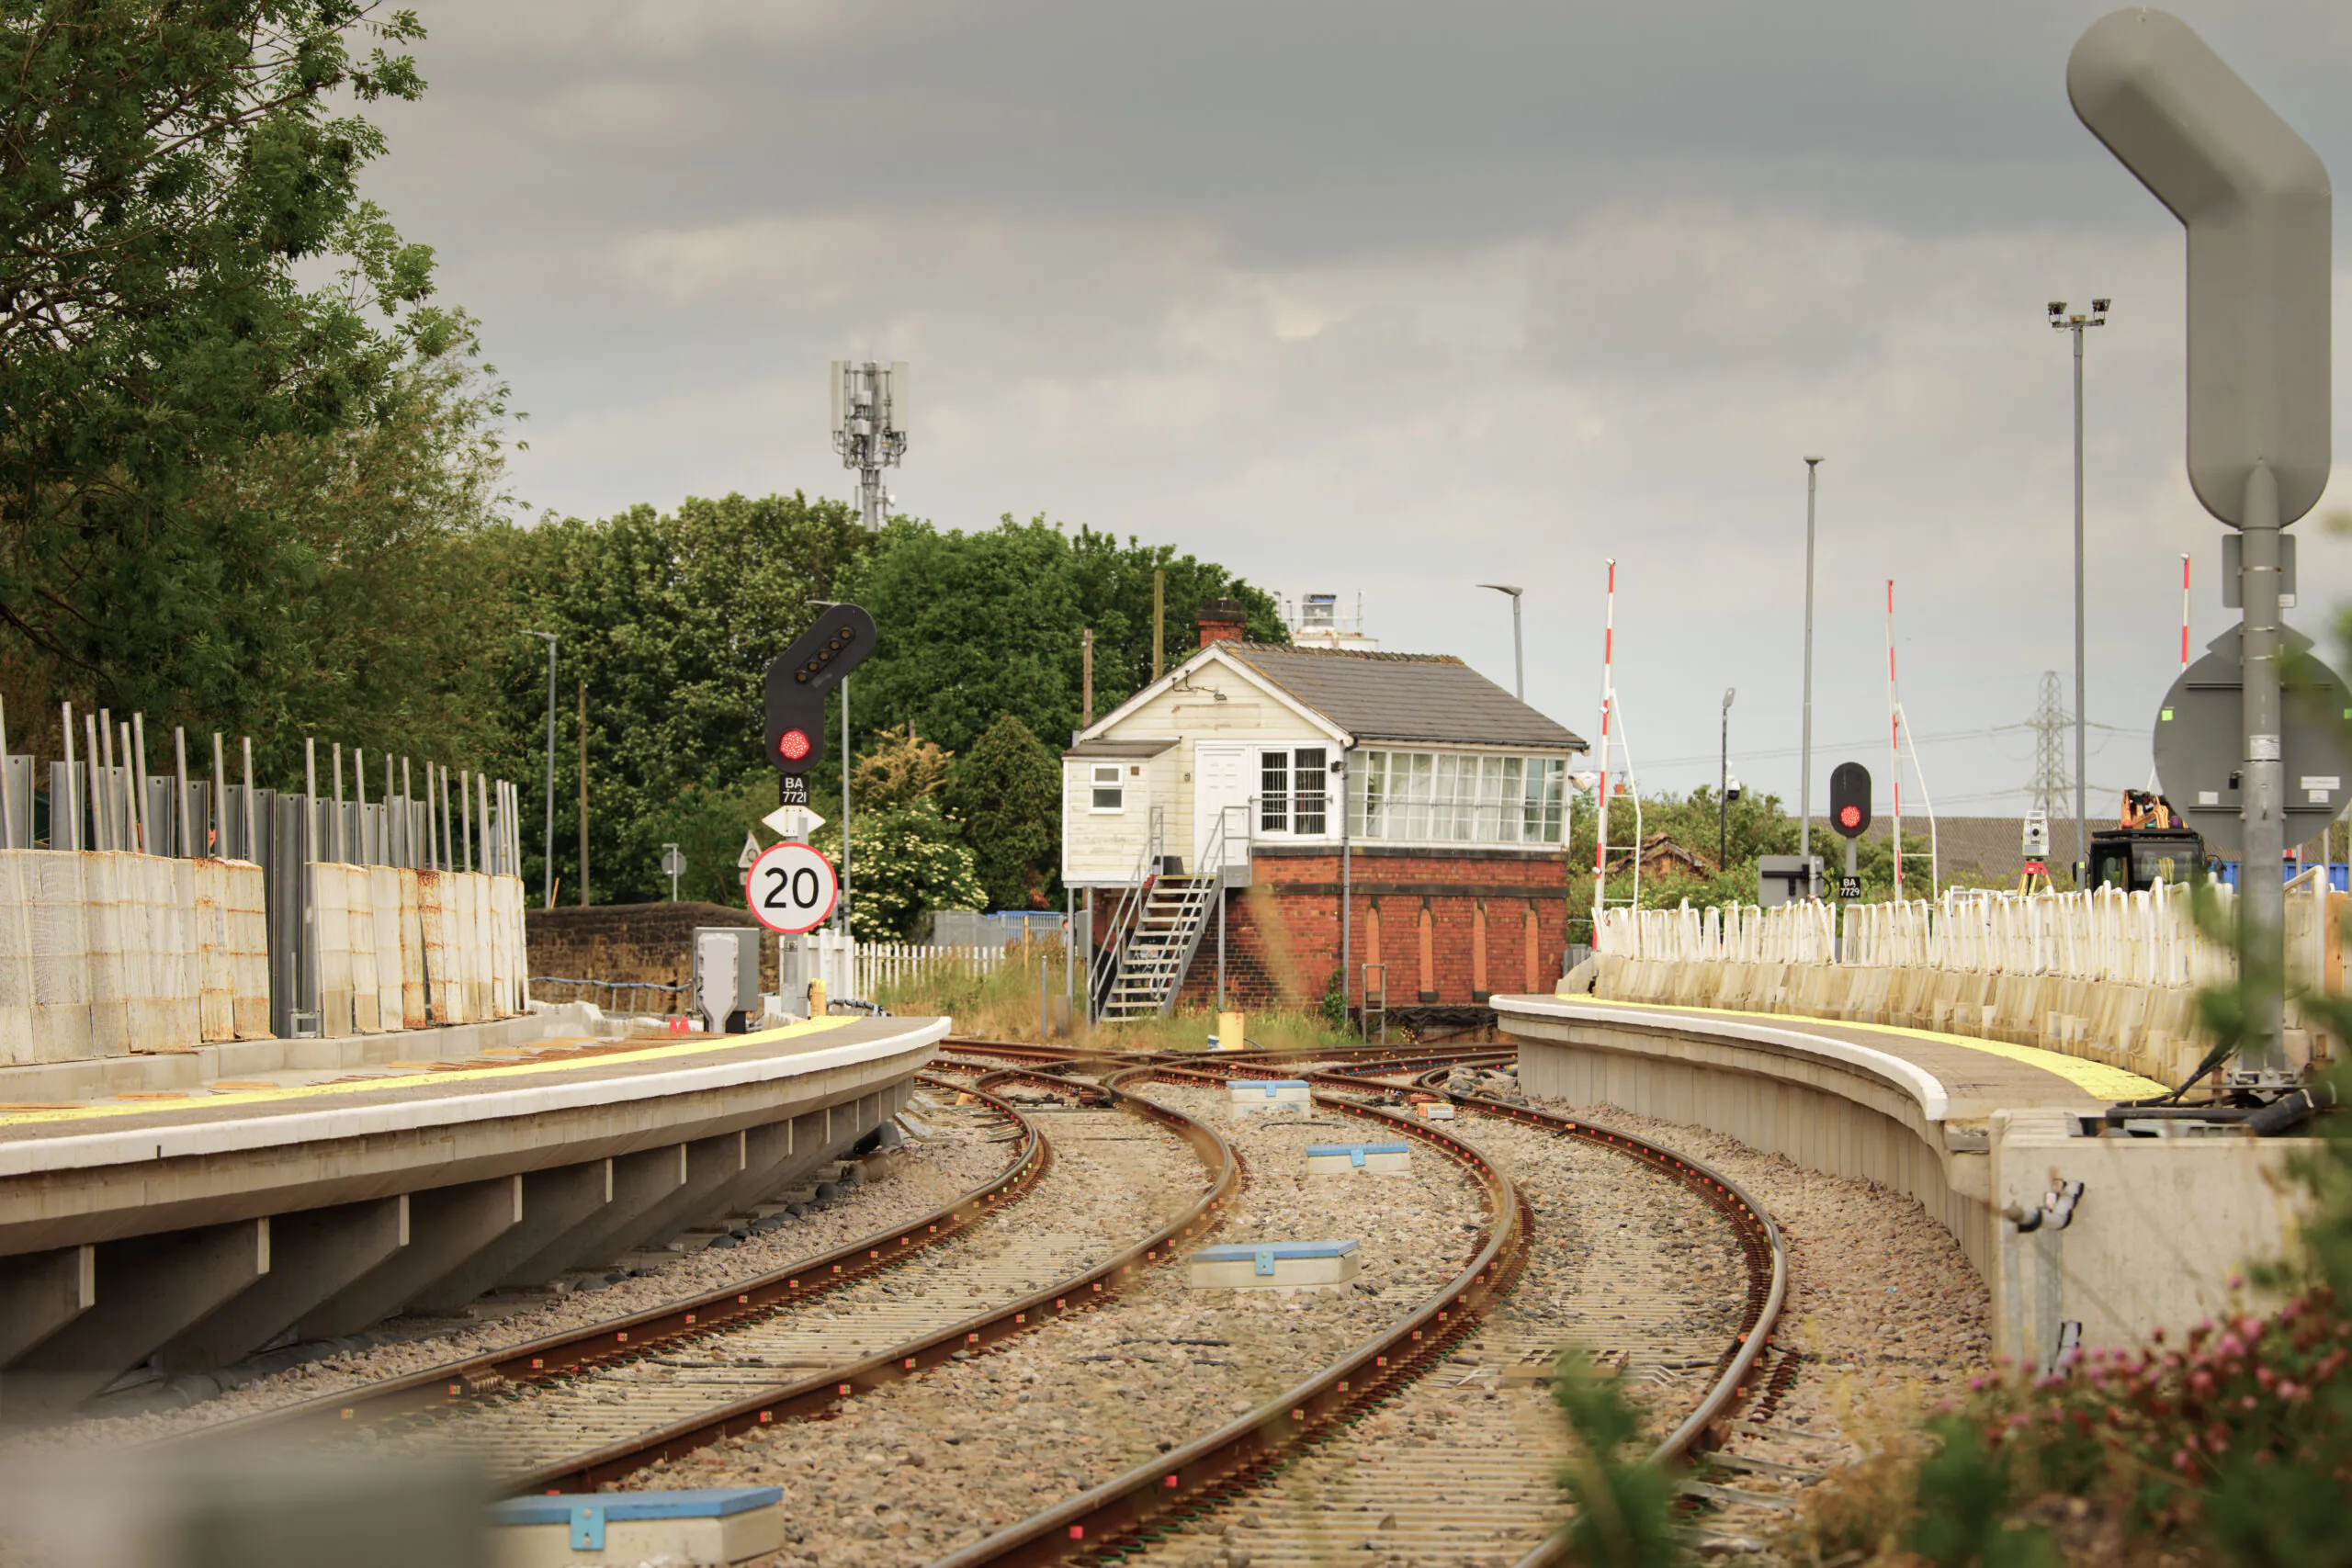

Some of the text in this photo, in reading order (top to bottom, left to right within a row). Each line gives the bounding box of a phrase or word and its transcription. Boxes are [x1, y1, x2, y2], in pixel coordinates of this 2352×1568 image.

[785, 777, 804, 789] BA
[782, 791, 807, 803] 7721
[763, 867, 820, 909] 20
[1843, 877, 1857, 887] BA
[1840, 887, 1860, 897] 7729
